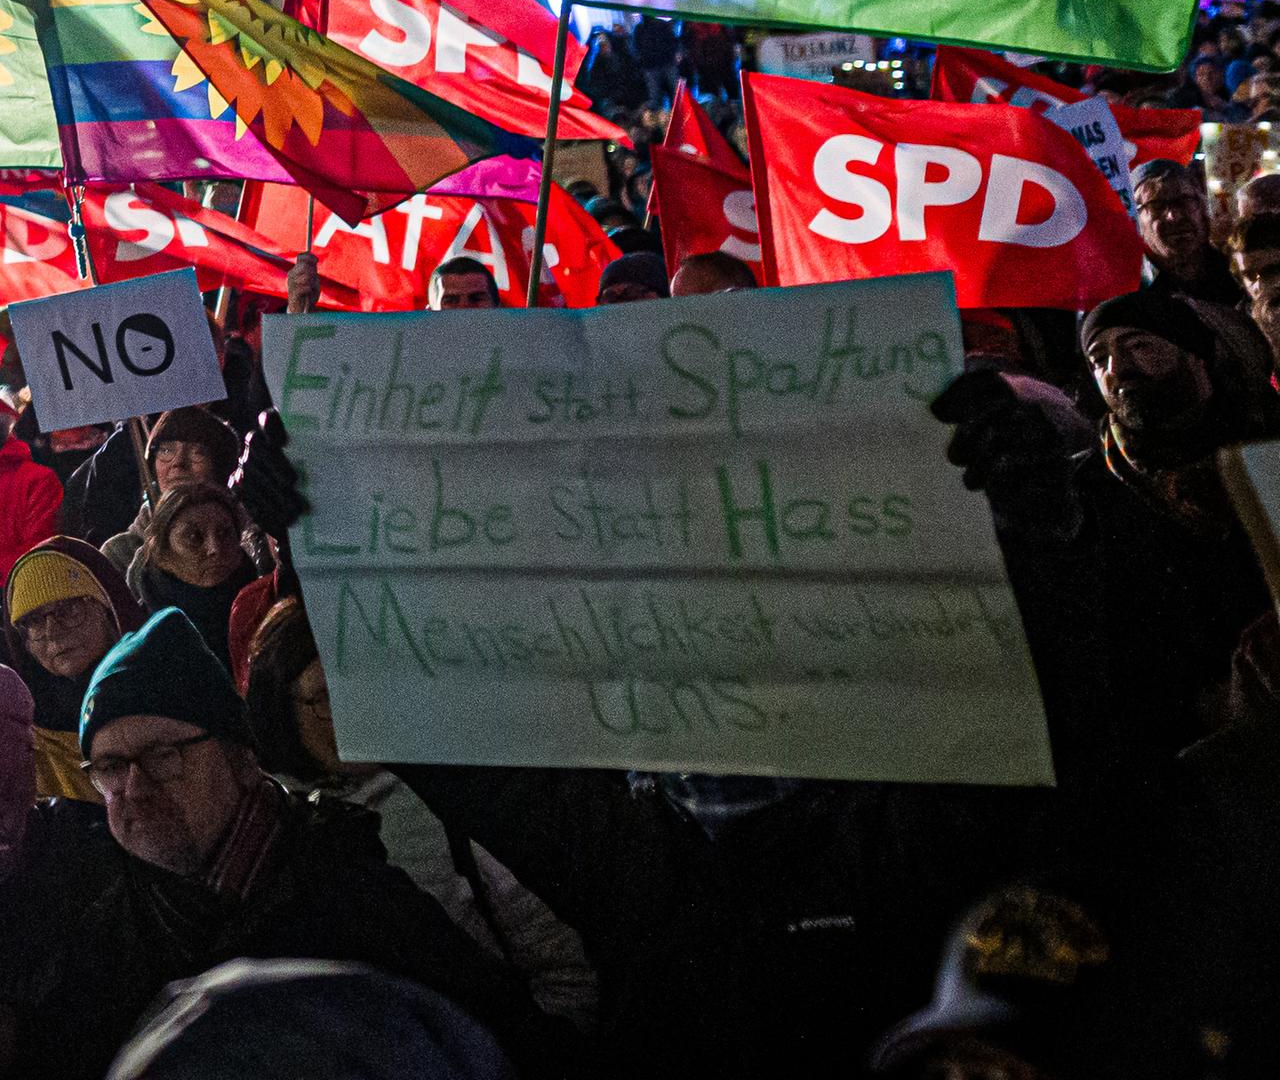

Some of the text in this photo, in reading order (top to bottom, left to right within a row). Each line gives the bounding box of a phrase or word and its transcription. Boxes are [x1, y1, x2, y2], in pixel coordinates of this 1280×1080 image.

[808, 133, 1088, 248] SPD
[51, 312, 175, 390] NO
[282, 324, 506, 437] Einheit
[661, 306, 950, 440] Spaltung
[302, 457, 515, 557] Liebe
[716, 460, 914, 563] Hass
[336, 578, 780, 679] Menschlichkeit
